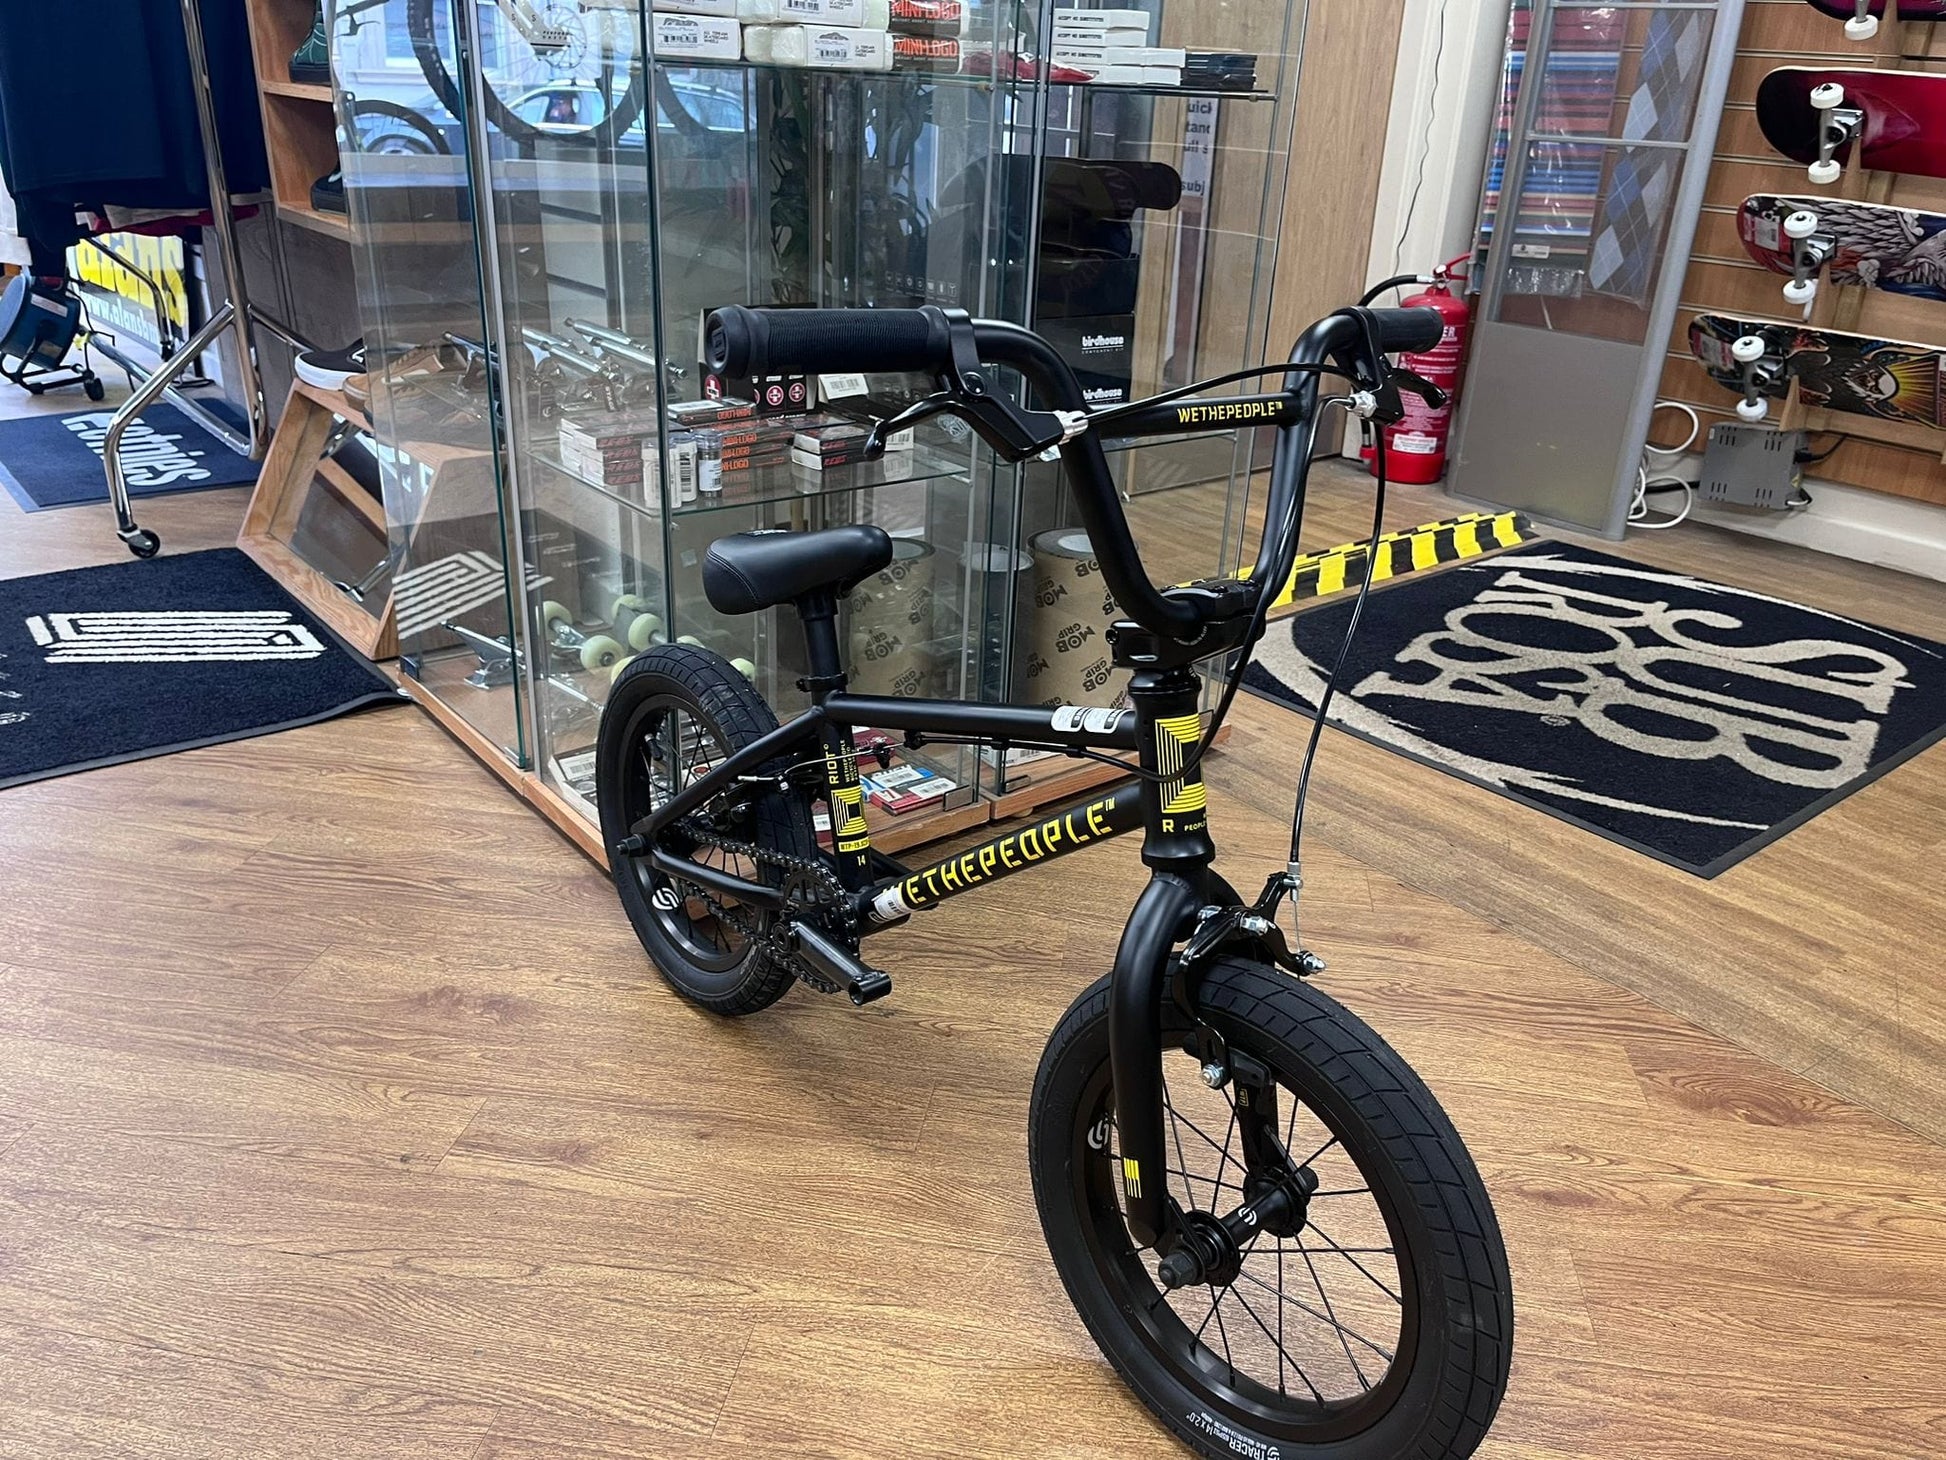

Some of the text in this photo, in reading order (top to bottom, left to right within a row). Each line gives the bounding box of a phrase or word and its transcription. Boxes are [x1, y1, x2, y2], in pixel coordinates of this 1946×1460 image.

[1082, 335, 1124, 347] birdhouse
[1082, 388, 1123, 400] birdhouse
[1074, 559, 1100, 577] OB
[1055, 625, 1096, 653] MOB
[1058, 622, 1081, 639] GRIP
[864, 635, 902, 661] MOB
[1085, 659, 1107, 679] GRIP
[1162, 819, 1175, 833] R
[1229, 1436, 1265, 1460] TRACER
